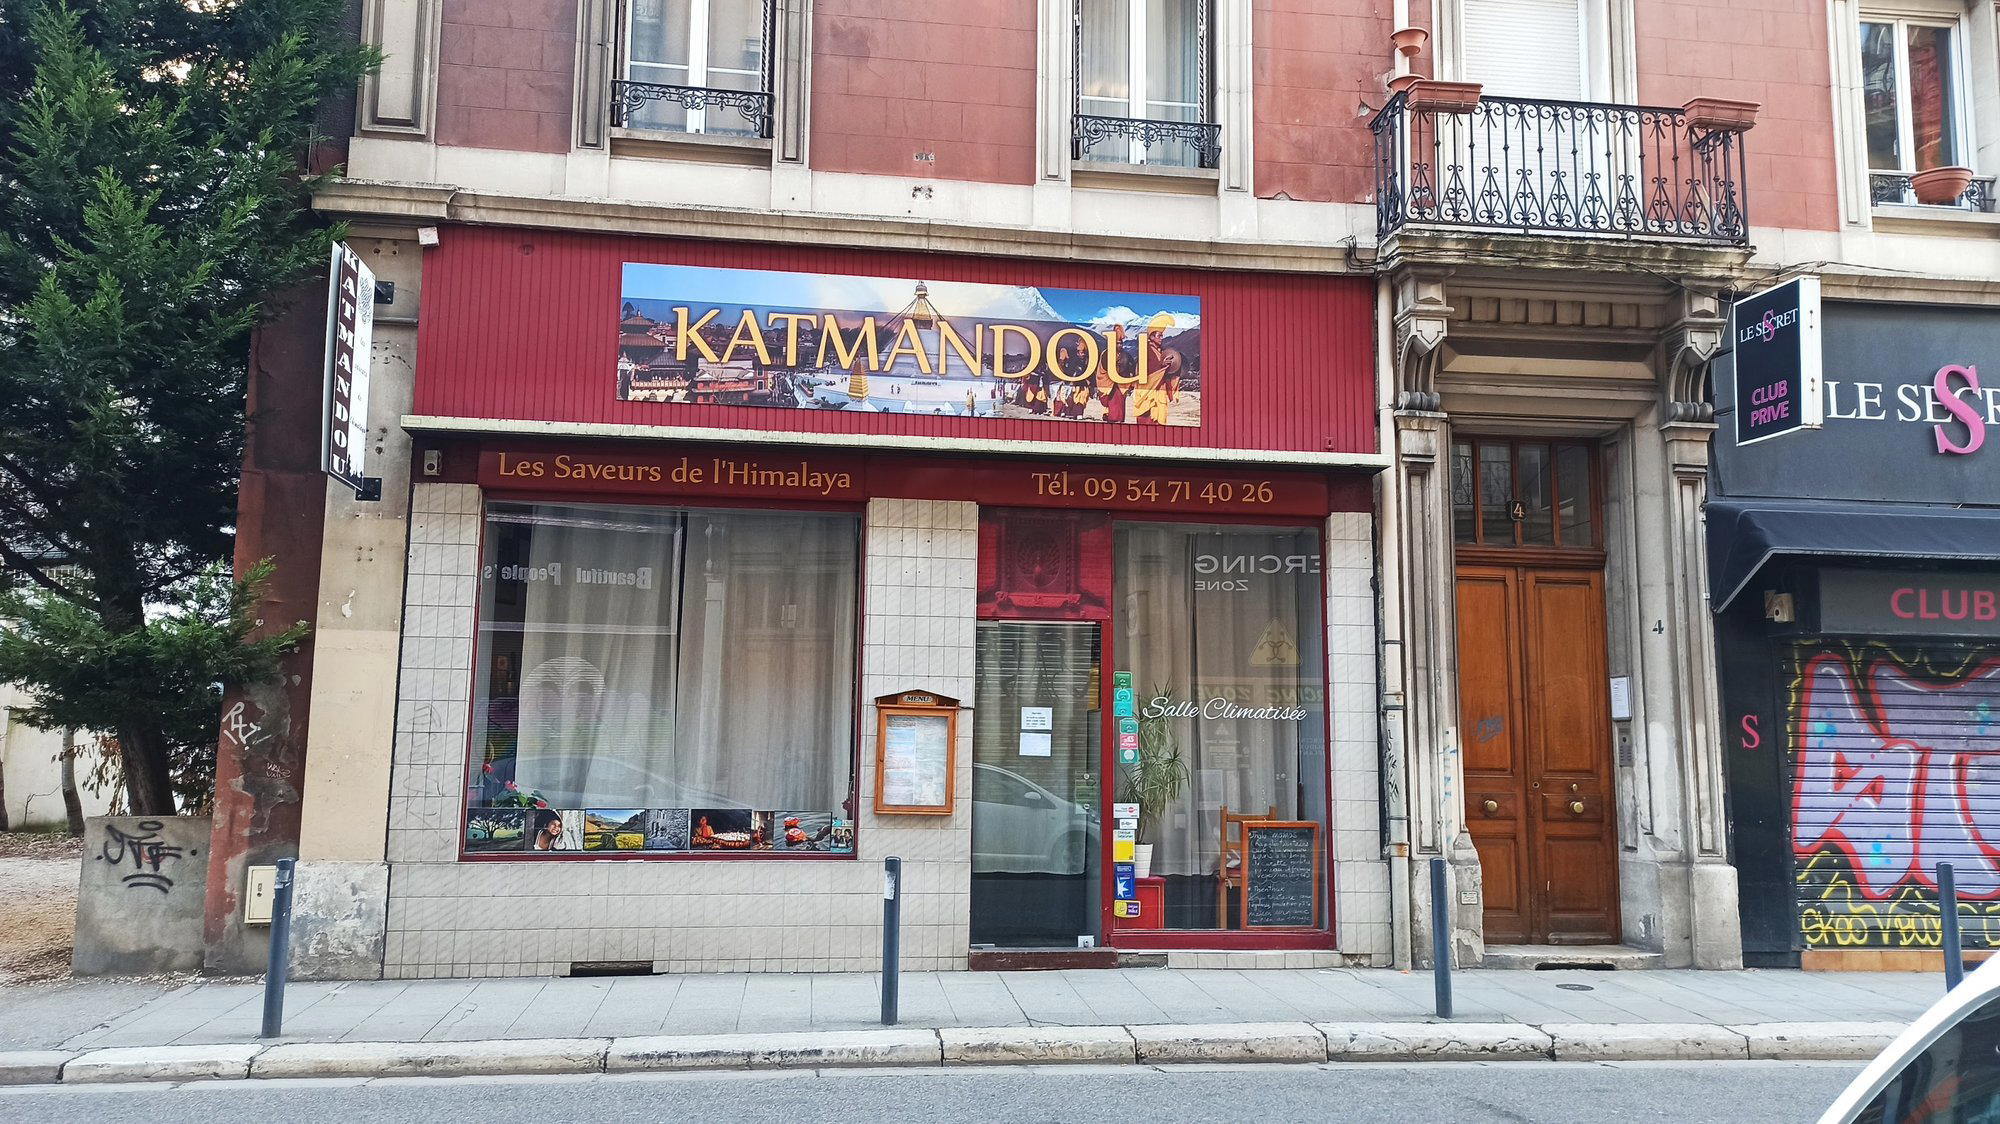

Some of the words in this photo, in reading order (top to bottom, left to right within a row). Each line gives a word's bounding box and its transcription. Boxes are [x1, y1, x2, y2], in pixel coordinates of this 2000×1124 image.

[1740, 326, 1755, 343] LE
[1755, 308, 1799, 338] SECRET
[332, 246, 359, 475] KATMANDOU
[671, 305, 1150, 385] KATMANDOU
[1751, 380, 1788, 406] CLUB
[1824, 381, 1887, 420] LE
[1750, 401, 1790, 427] PRIVE
[498, 452, 545, 477] Les
[554, 455, 662, 482] Saveurs
[671, 457, 703, 483] de
[713, 458, 851, 495] l'Himalaya
[1031, 471, 1075, 496] Tél.
[1084, 478, 1117, 500] 09
[1126, 479, 1160, 502] 54
[1168, 480, 1190, 503] 71
[1200, 481, 1233, 504] 40
[1242, 481, 1274, 503] 26
[1513, 502, 1526, 518] 4
[1890, 588, 1997, 620] CLUB
[1652, 619, 1665, 635] 4
[906, 695, 929, 703] MENU
[1142, 696, 1201, 719] Salle
[1203, 697, 1308, 721] Climatisée
[1741, 714, 1761, 750] S
